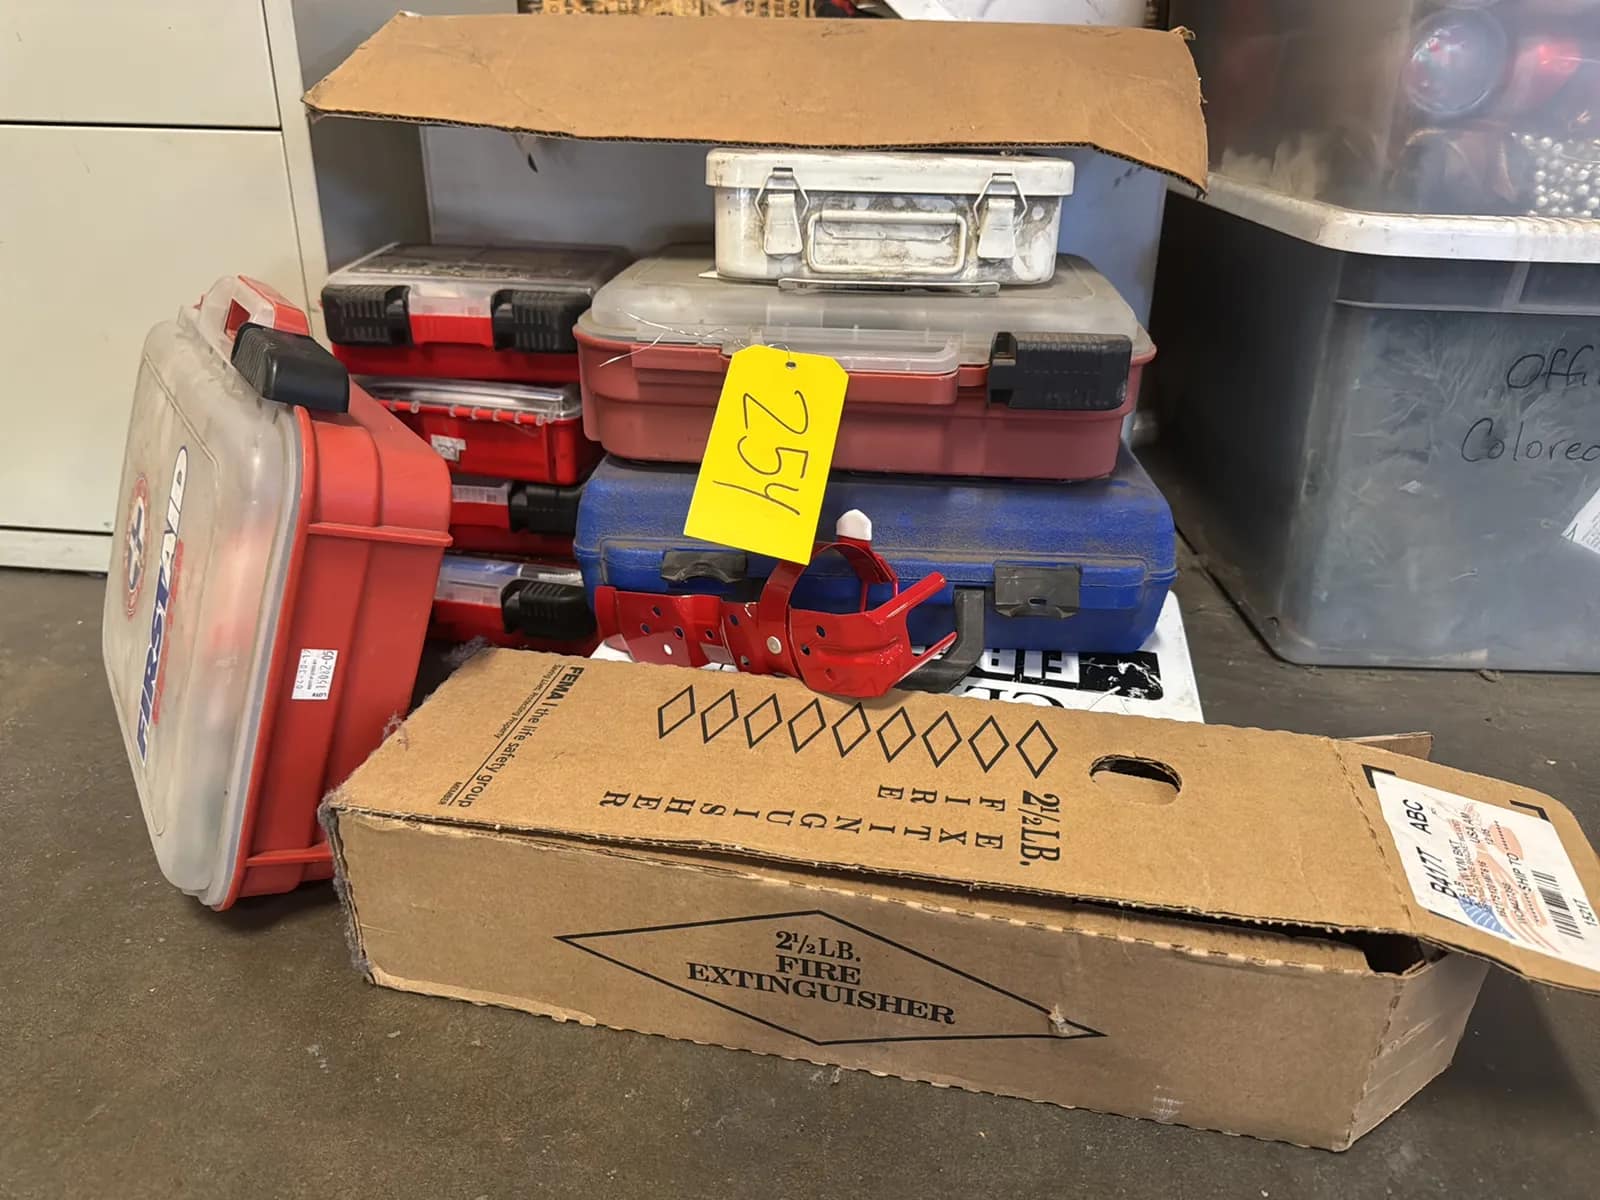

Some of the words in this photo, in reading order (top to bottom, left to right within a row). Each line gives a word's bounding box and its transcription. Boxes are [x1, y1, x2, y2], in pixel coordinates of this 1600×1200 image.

[713, 389, 810, 516] 254
[546, 666, 585, 700] FEMA
[527, 708, 550, 724] the
[513, 725, 539, 741] life
[485, 742, 520, 773] safety
[457, 774, 494, 808] group
[877, 784, 1006, 812] FIRE
[599, 790, 1004, 850] EXTINGUISHER
[1403, 798, 1432, 835] ABC
[1417, 846, 1459, 899] B417T
[1507, 852, 1522, 866] TO
[1512, 868, 1532, 893] SHIP
[775, 954, 861, 986] FIRE
[686, 962, 956, 1025] EXTINGUISHER
